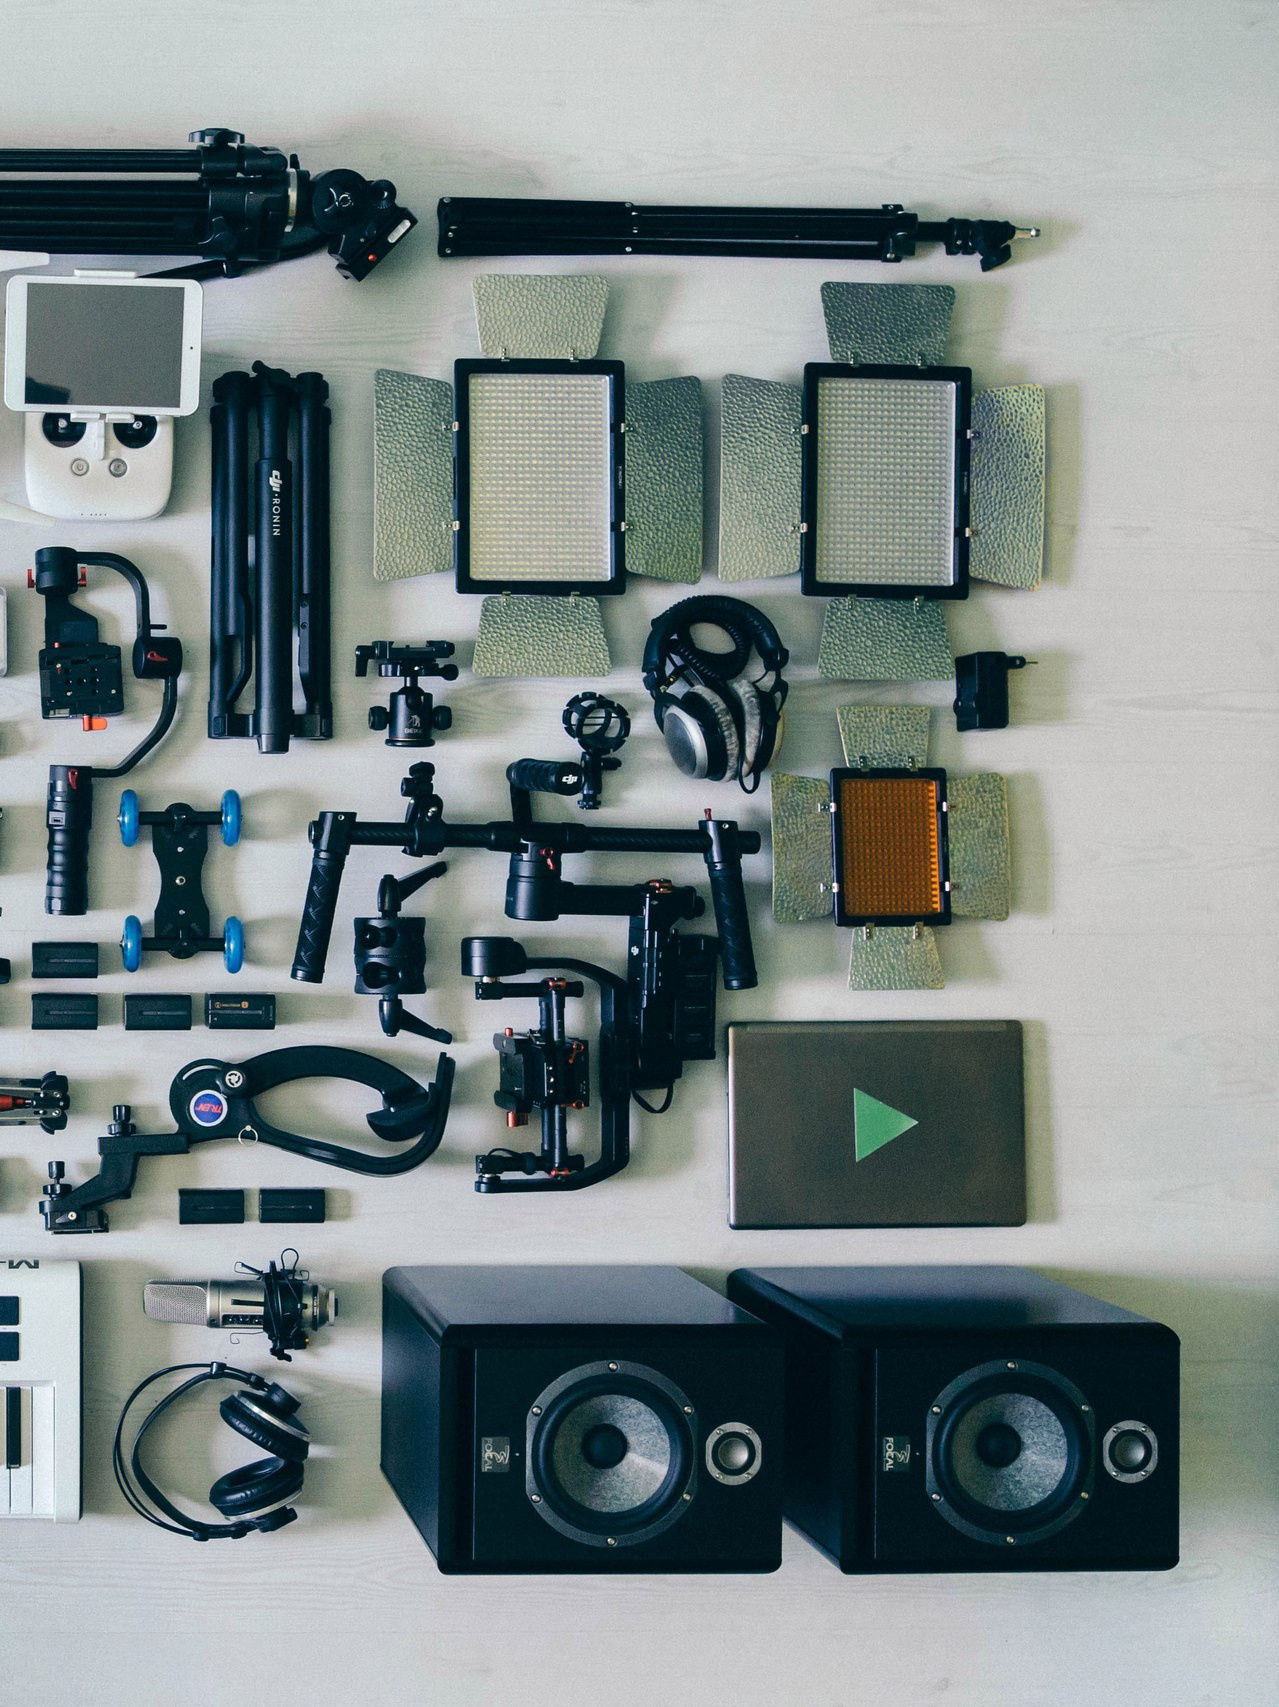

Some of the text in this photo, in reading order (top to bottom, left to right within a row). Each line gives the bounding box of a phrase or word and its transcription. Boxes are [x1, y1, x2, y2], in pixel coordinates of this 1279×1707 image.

[269, 470, 282, 535] dji RONIN
[562, 774, 578, 784] dji
[886, 1437, 894, 1471] FOCAL
